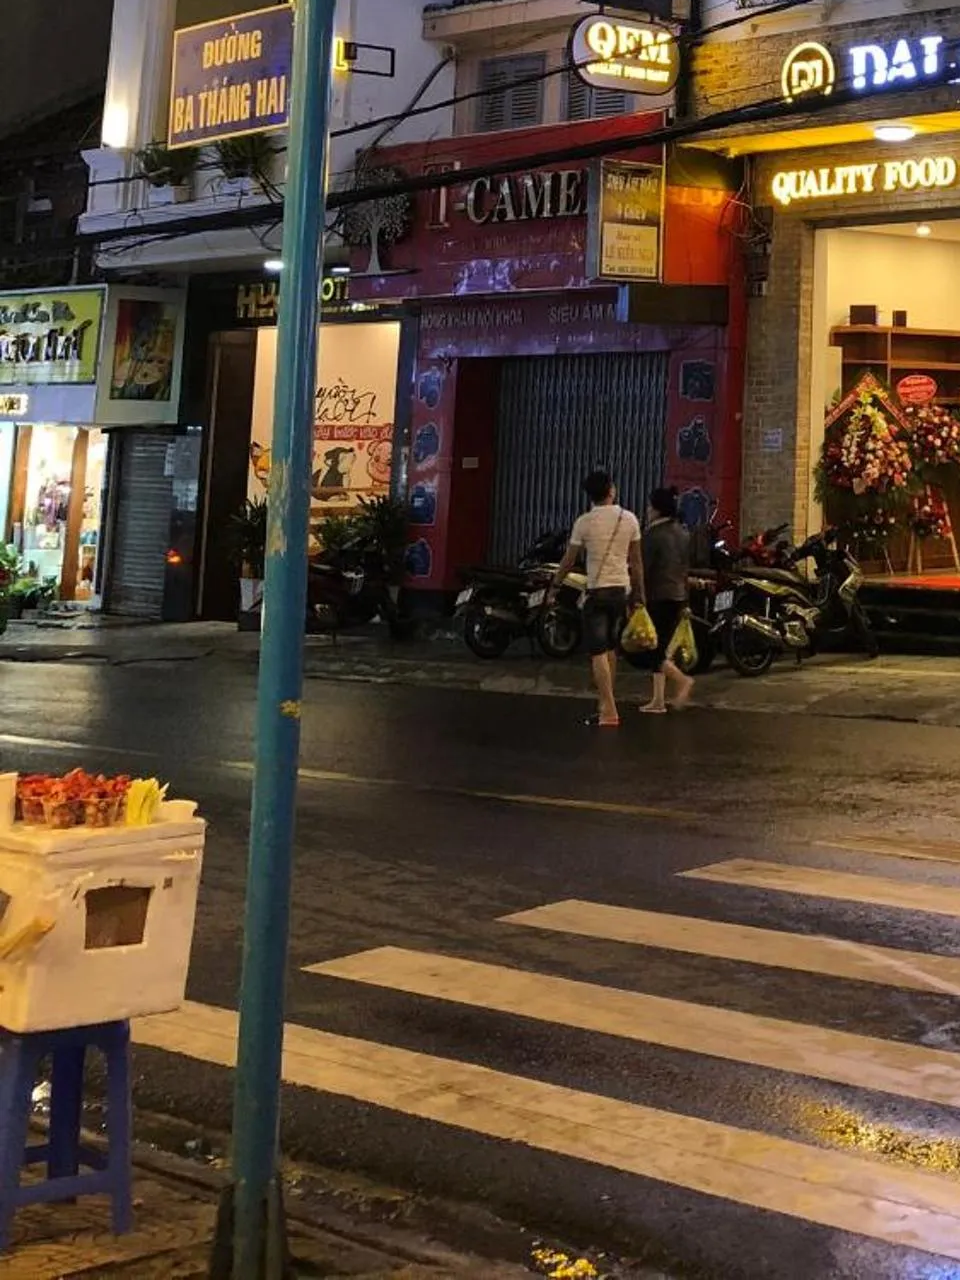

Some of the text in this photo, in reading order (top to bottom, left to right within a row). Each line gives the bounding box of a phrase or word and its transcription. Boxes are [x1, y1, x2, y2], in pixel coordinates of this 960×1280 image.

[202, 23, 262, 69] ĐƯỜNG
[587, 21, 673, 64] QFM
[174, 75, 287, 134] BA THÁNG HAI
[772, 162, 878, 206] QUALITY
[883, 156, 956, 191] FOOD
